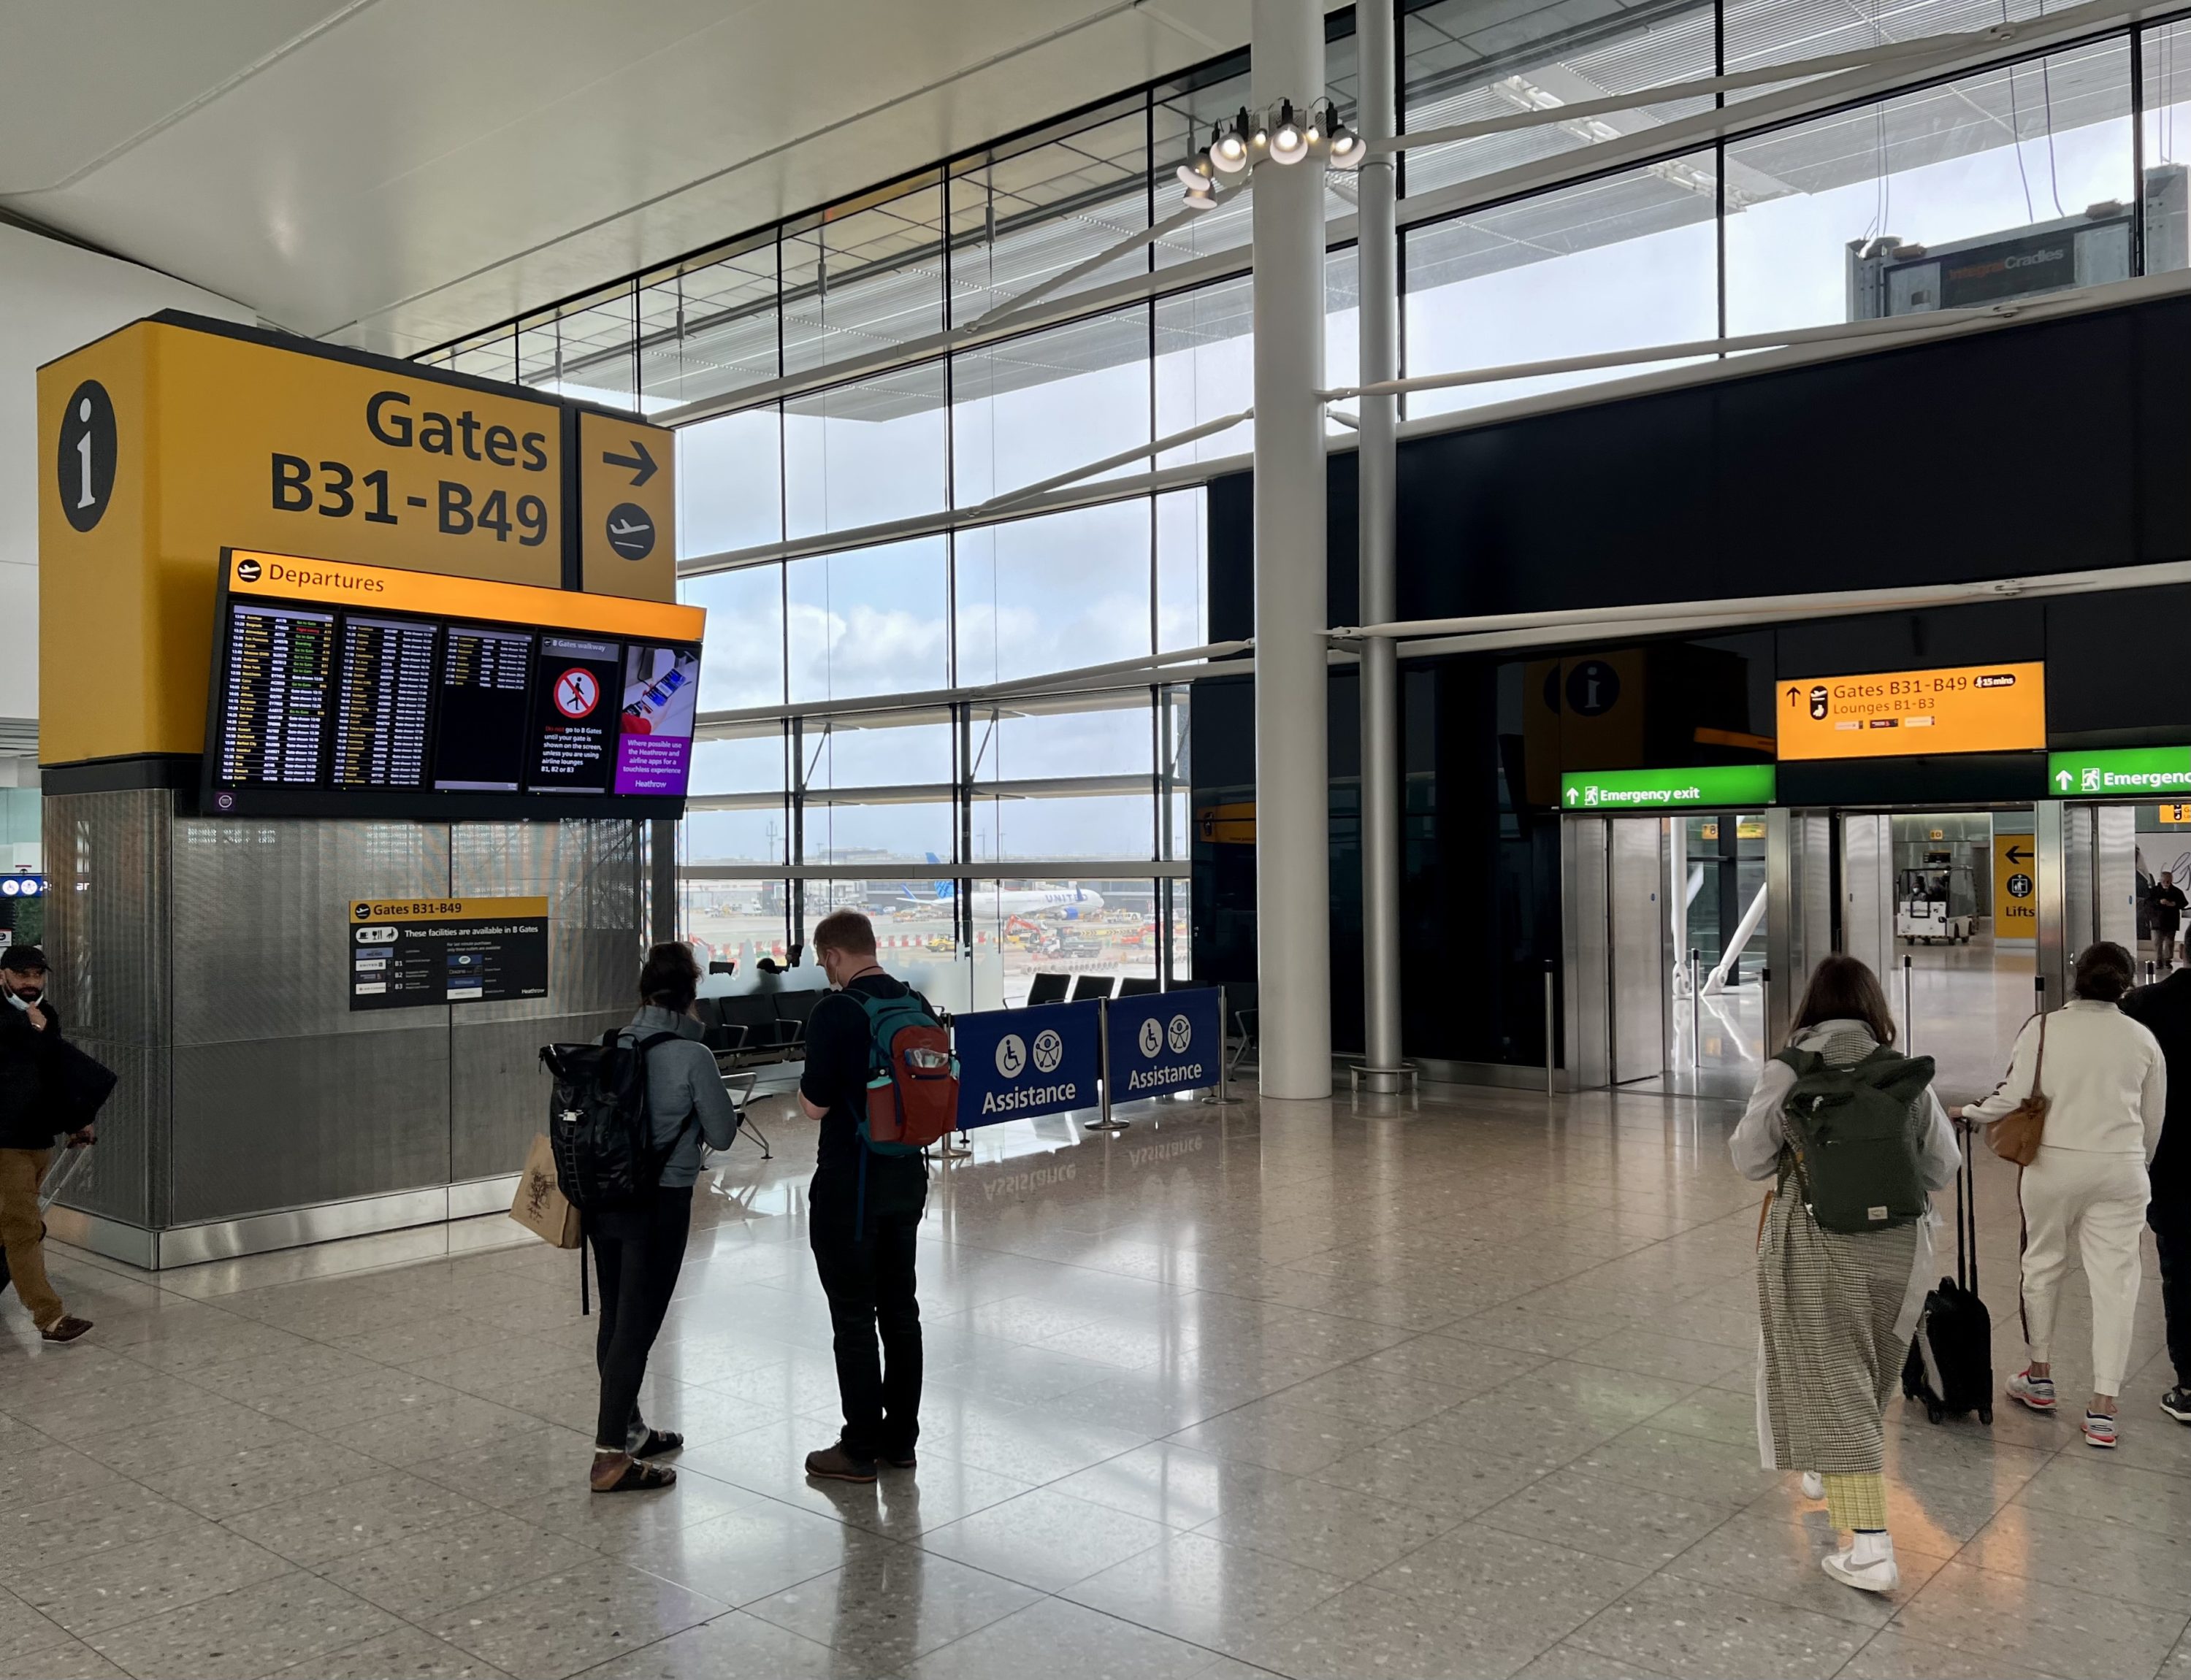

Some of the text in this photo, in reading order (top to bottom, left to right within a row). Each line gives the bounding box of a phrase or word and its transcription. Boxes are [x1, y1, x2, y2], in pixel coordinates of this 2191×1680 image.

[367, 390, 548, 472] Gates
[271, 453, 548, 546] B31-B49
[269, 564, 385, 593] Departures
[578, 643, 605, 652] walkway
[1834, 684, 1884, 699] Gates
[1890, 676, 1967, 694] B31-B49
[1834, 698, 1935, 715] Lounges B1-B3
[635, 780, 667, 788] Heathrow
[1601, 787, 1700, 803] Emergency exit
[374, 903, 462, 916] Gates B31-B49
[2006, 906, 2035, 917] Lifts
[405, 929, 427, 937] These
[429, 928, 457, 937] facilities
[504, 926, 511, 934] in
[519, 925, 538, 933] Gates
[1128, 1064, 1202, 1090] Assistance
[982, 1083, 1076, 1115] Assistance
